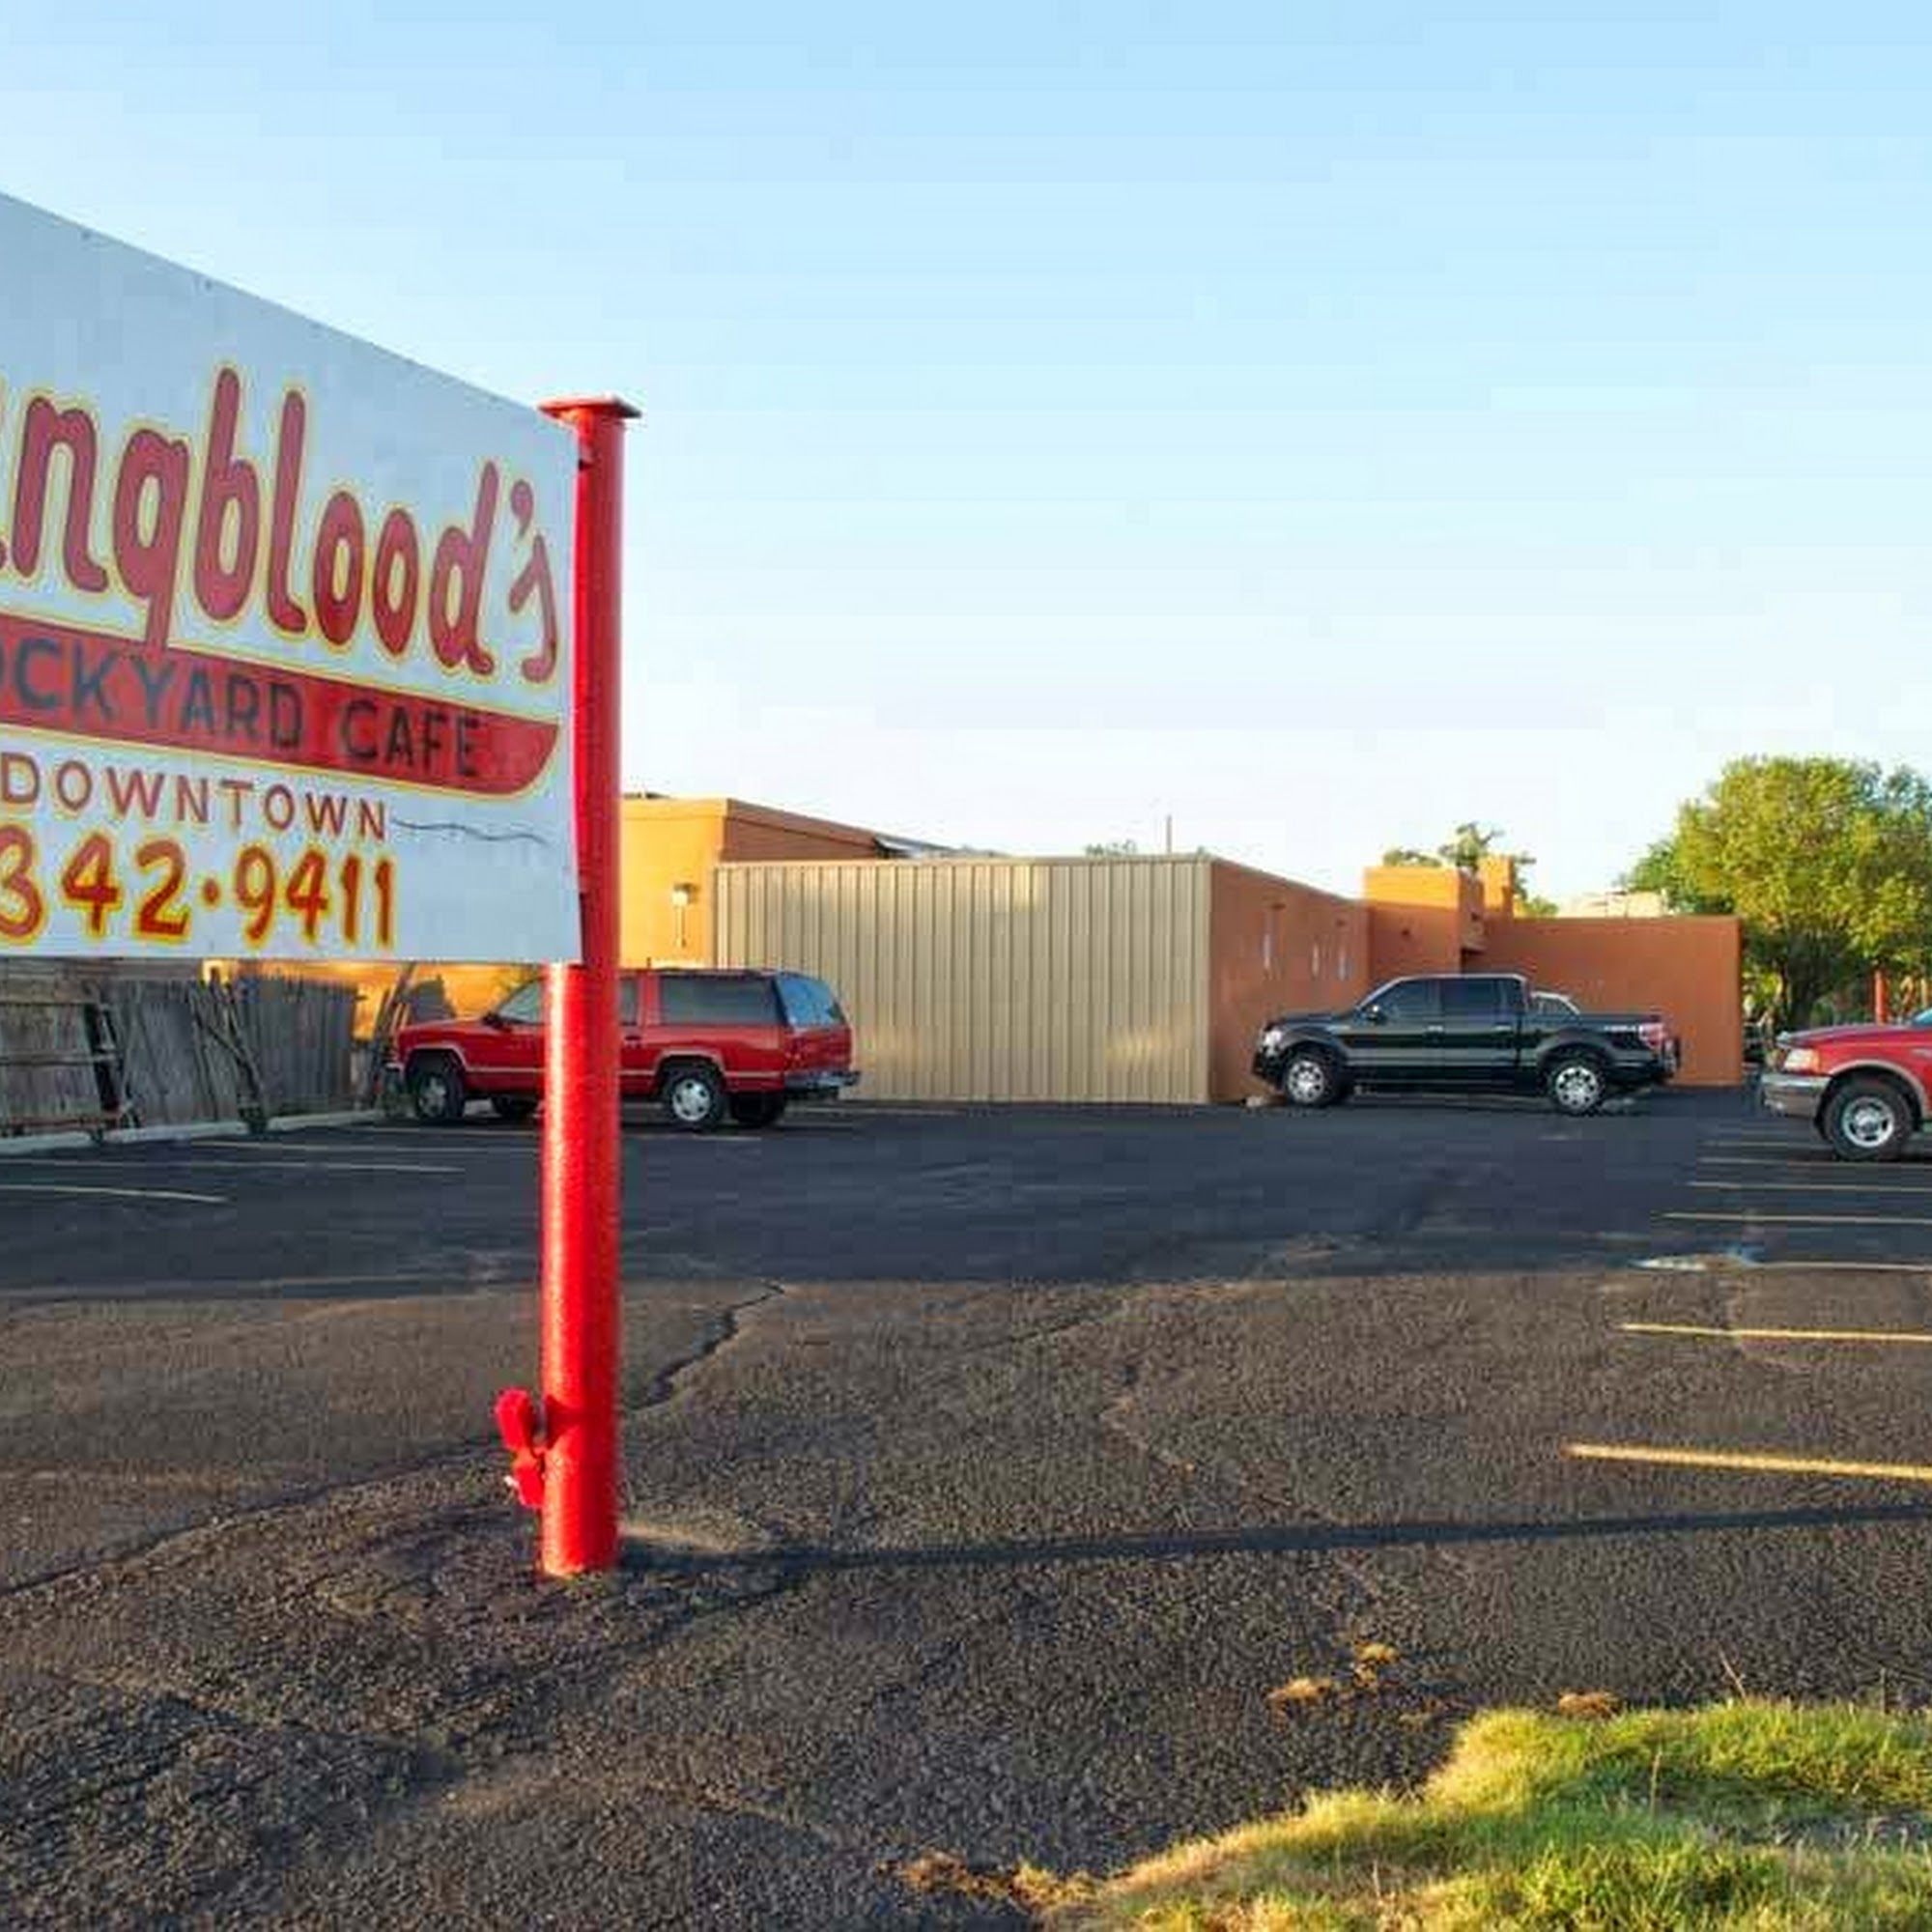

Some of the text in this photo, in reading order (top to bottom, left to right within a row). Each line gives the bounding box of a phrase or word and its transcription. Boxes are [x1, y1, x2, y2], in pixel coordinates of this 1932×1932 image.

[0, 366, 558, 684] ngblood's
[0, 636, 484, 778] CKYARD CAFE
[0, 752, 385, 841] DOWNTOWN
